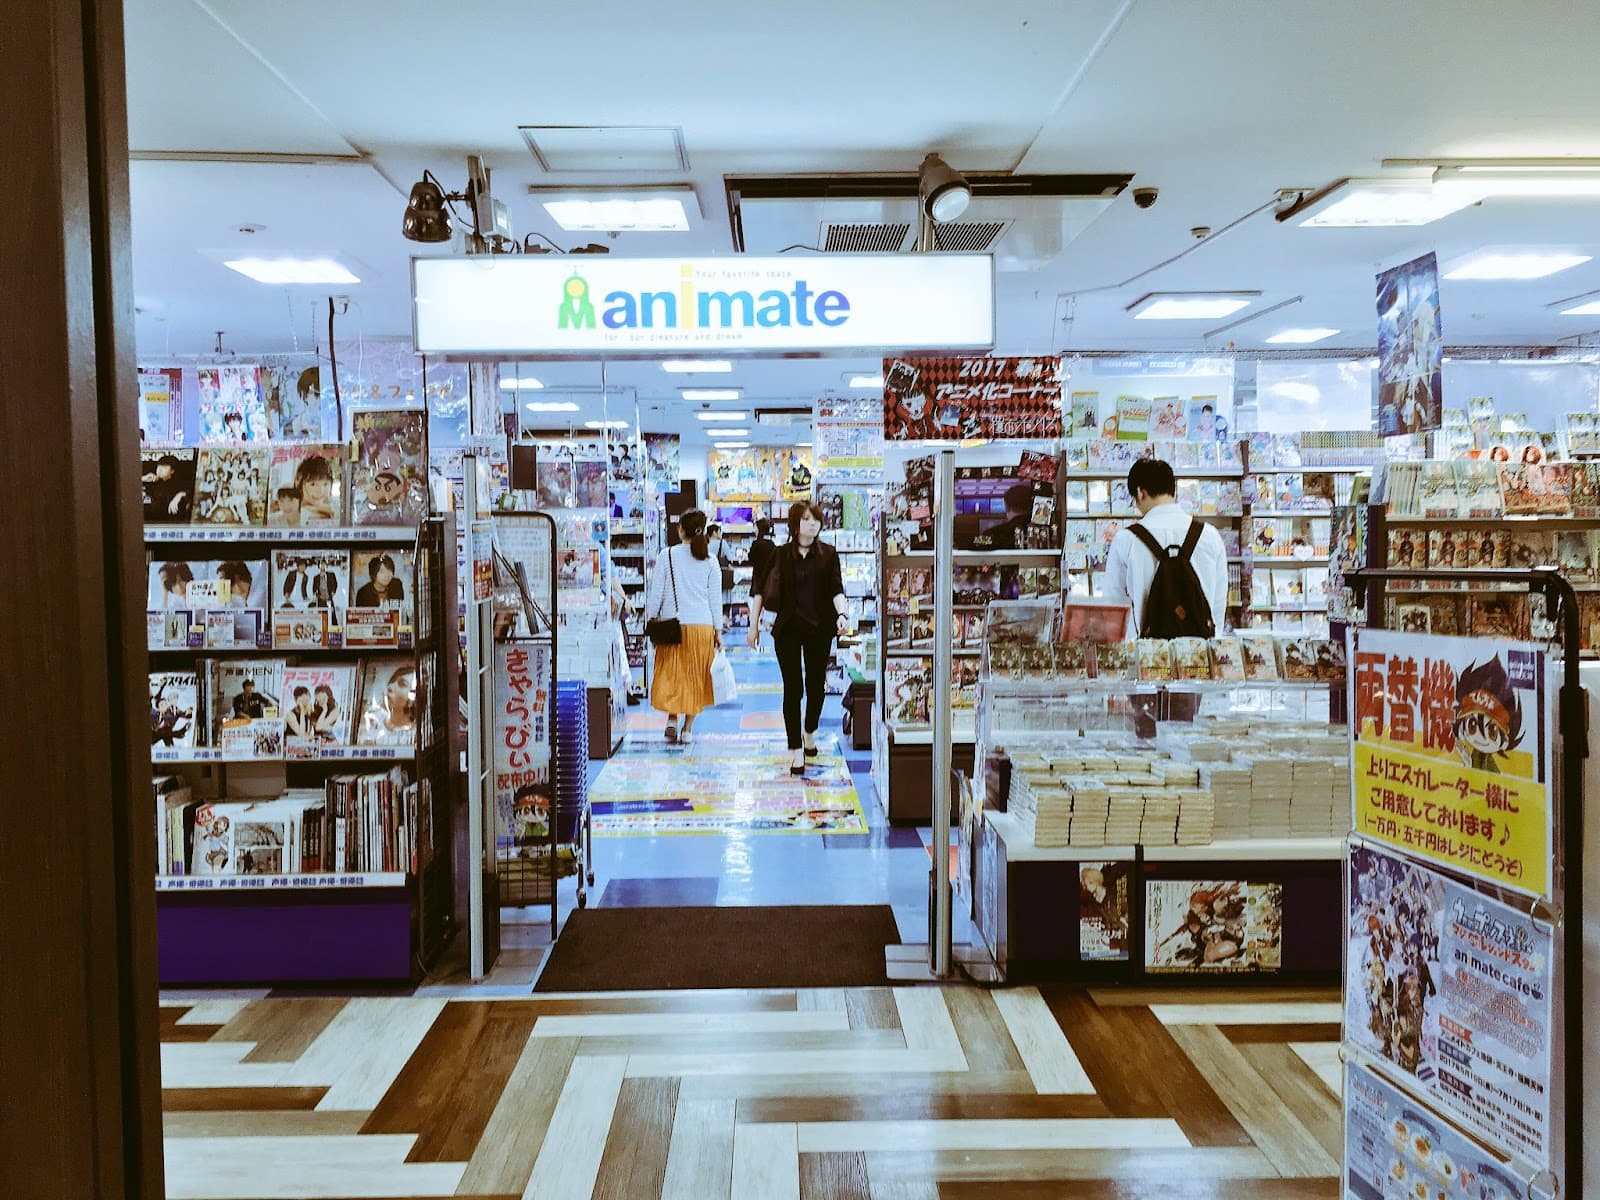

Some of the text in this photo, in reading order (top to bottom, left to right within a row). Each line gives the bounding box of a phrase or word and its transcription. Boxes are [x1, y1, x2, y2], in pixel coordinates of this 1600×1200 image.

[602, 264, 851, 329] animate
[959, 360, 1007, 377] 2017
[1355, 652, 1455, 753] 両替機
[1366, 753, 1519, 813] 上りエスカレーター横に
[1455, 949, 1530, 996] animate cafe
